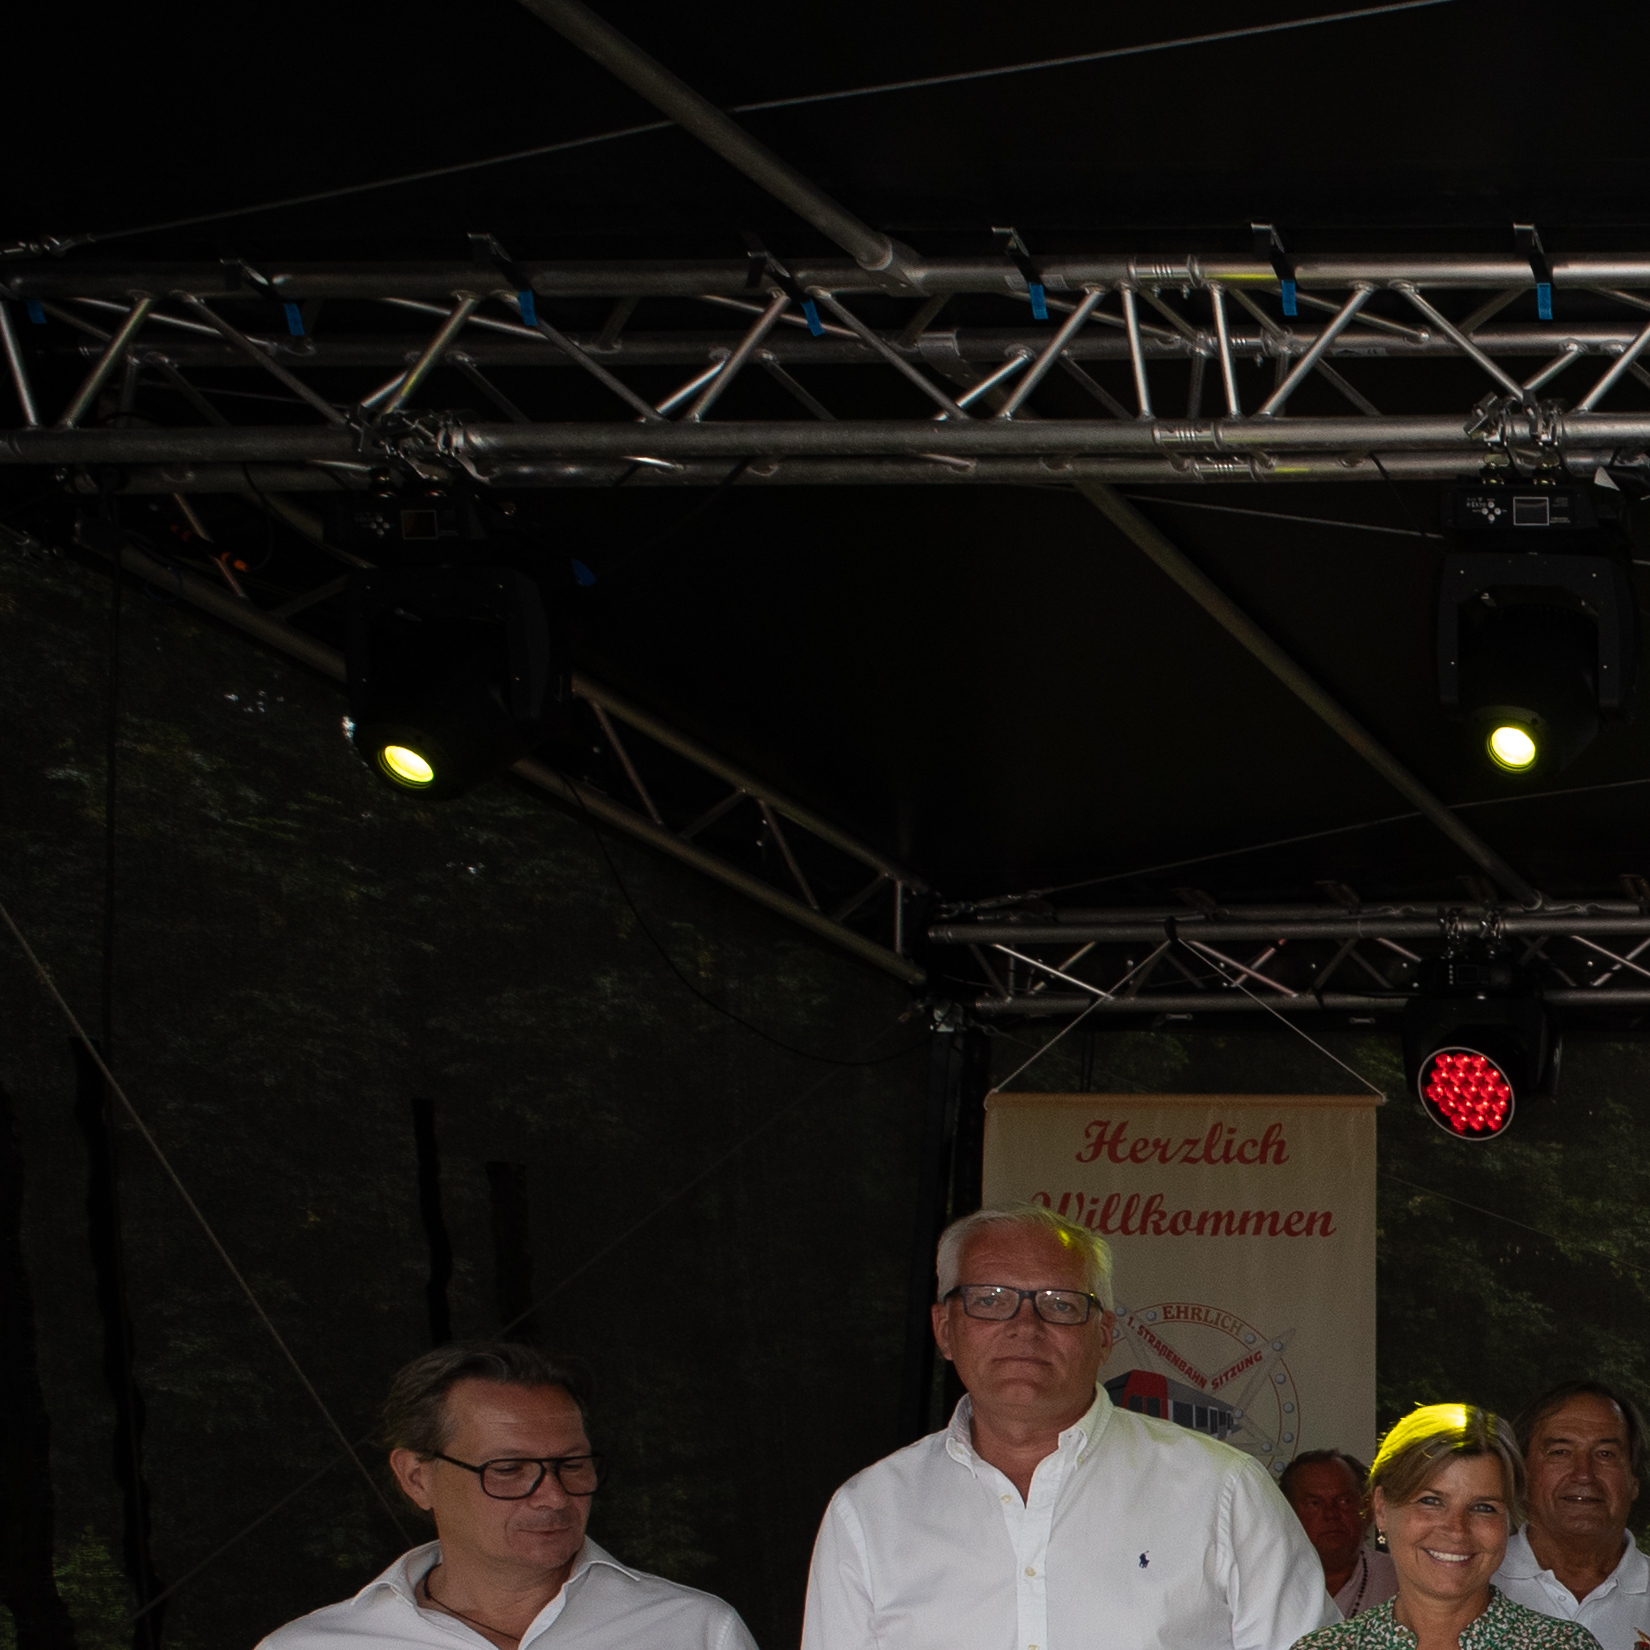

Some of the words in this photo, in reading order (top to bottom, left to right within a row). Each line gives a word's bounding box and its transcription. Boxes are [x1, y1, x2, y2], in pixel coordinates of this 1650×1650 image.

[1075, 1119, 1291, 1166] Herzlich
[1030, 1190, 1338, 1239] Willkommen
[1161, 1303, 1246, 1338] EHRLICH
[1210, 1349, 1264, 1391] SITZUNG
